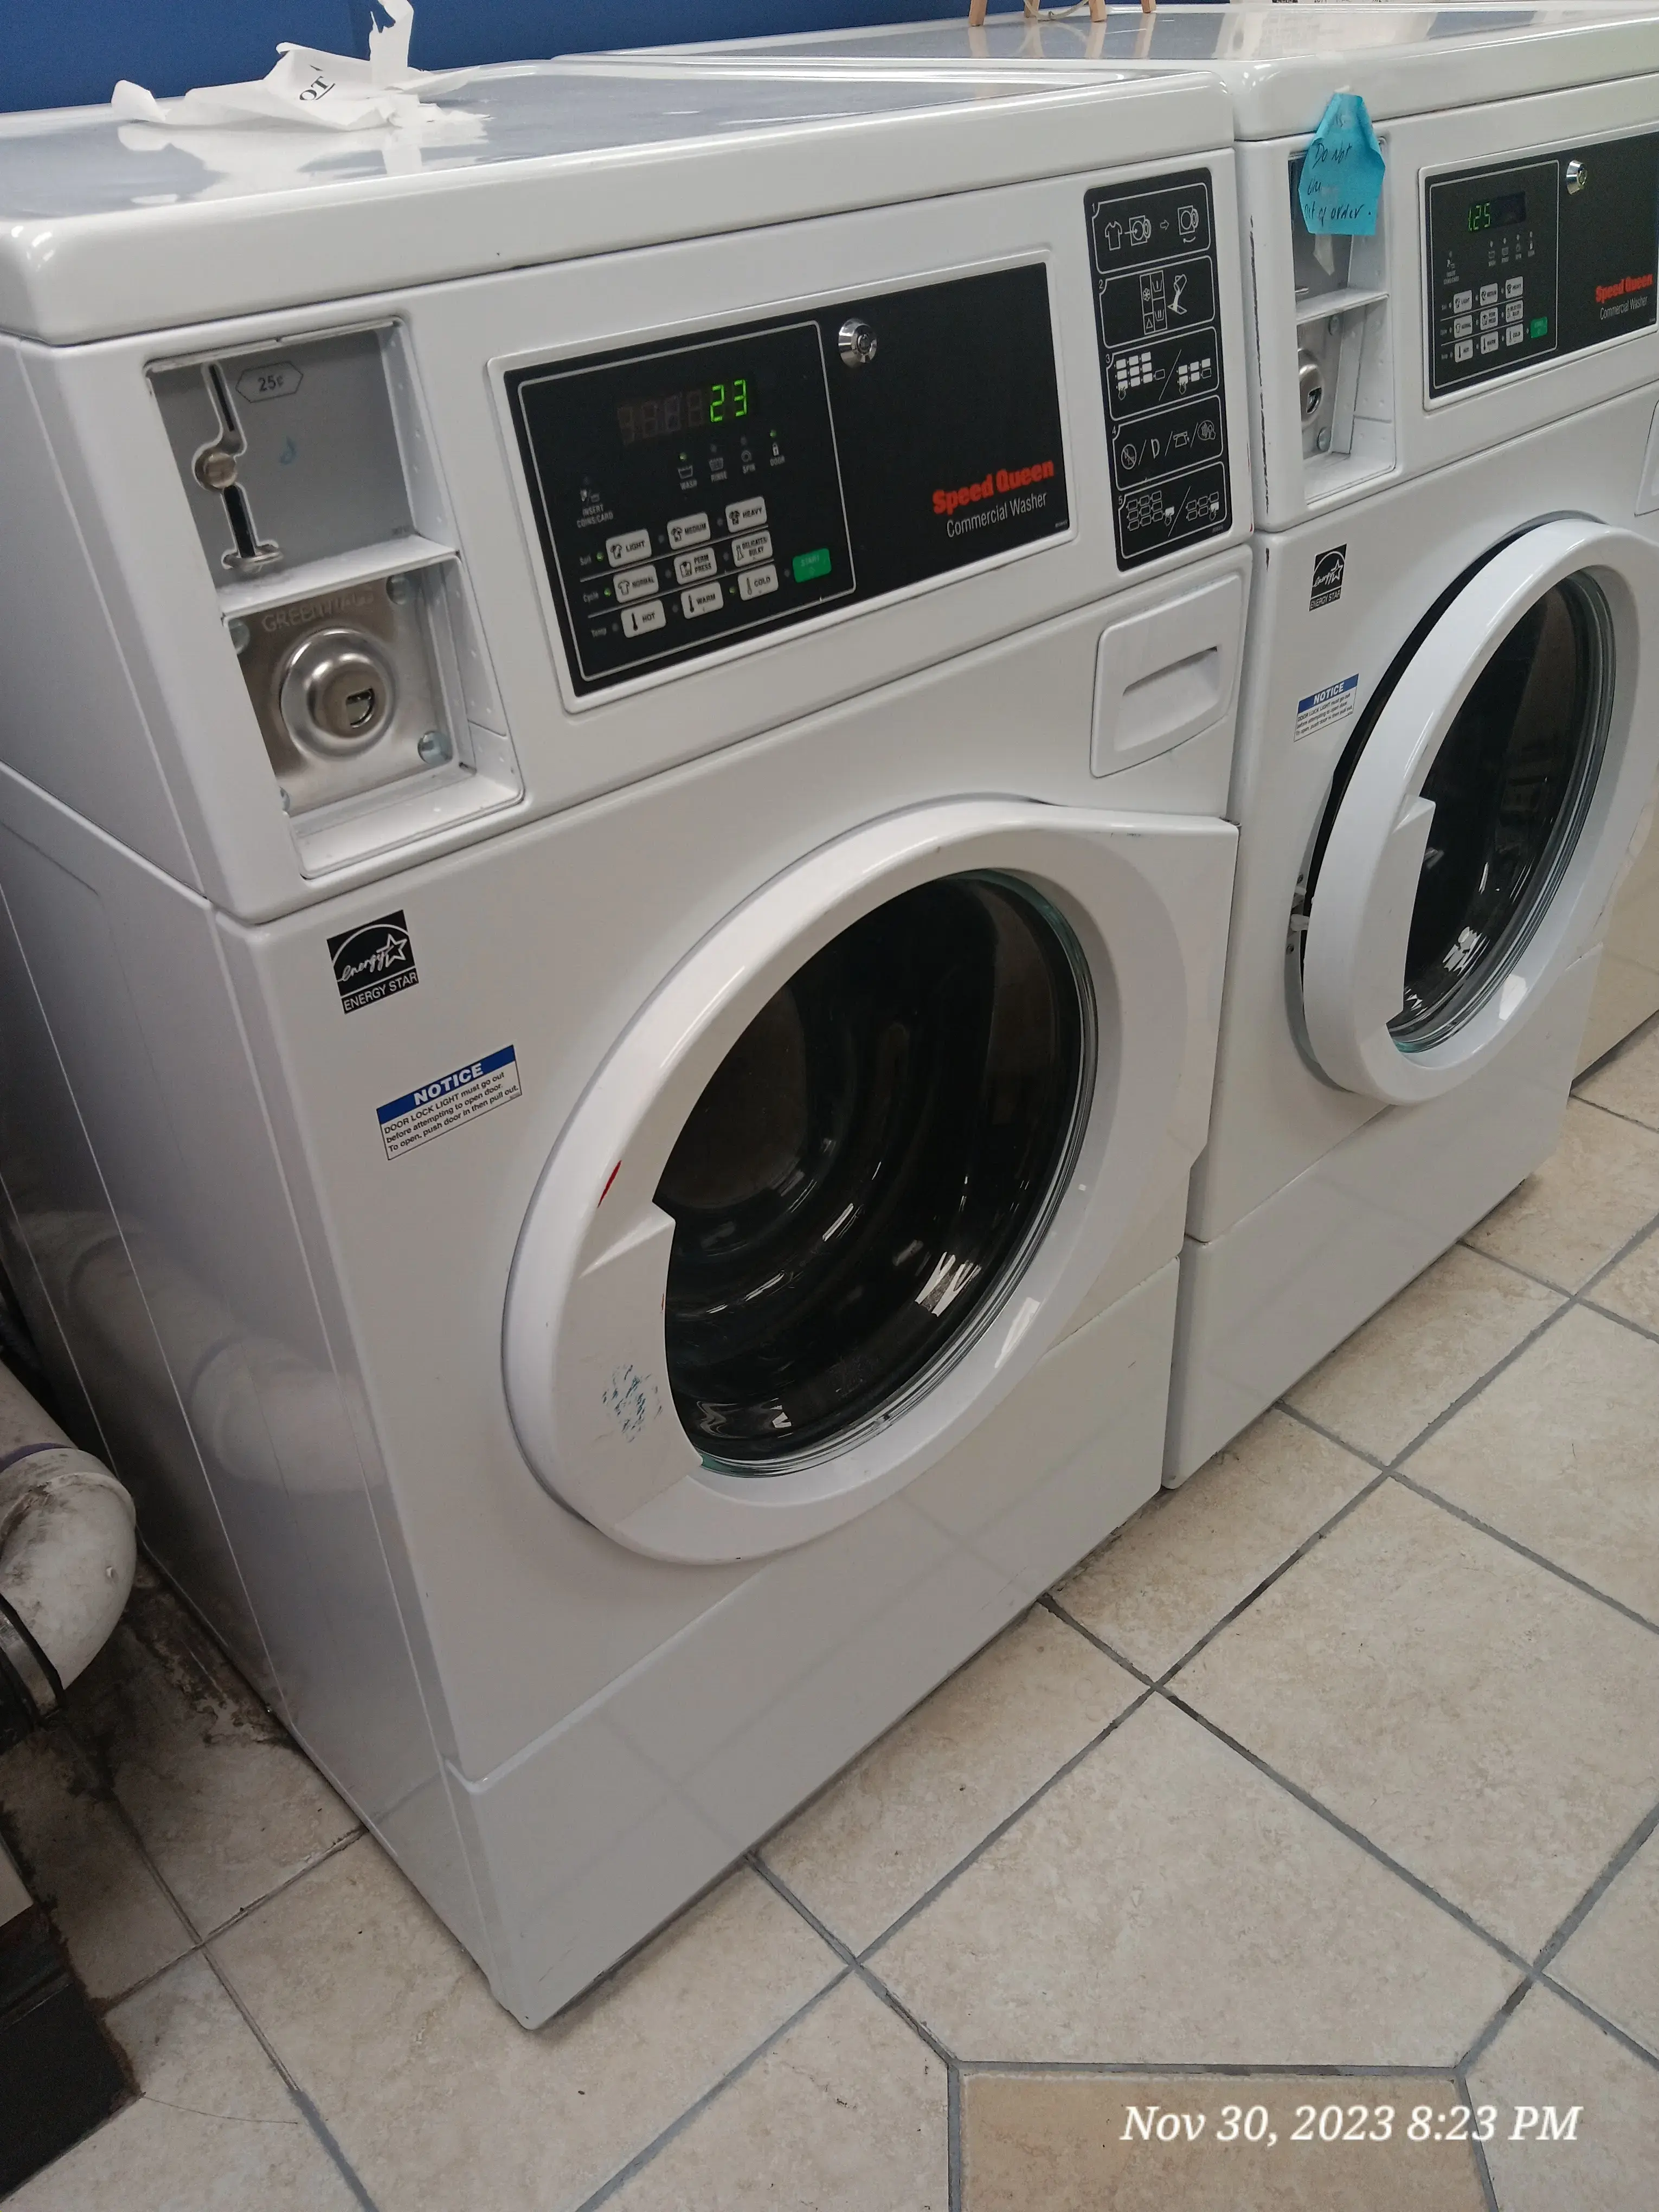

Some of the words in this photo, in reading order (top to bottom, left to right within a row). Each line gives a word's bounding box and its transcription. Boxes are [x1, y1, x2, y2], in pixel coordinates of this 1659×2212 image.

[1596, 278, 1624, 304] Speed
[1625, 273, 1652, 292] Queen
[1600, 300, 1629, 320] Commercial
[1630, 296, 1648, 310] Washer
[710, 379, 747, 423] 23
[932, 473, 994, 515] Speed
[995, 460, 1054, 493] Queen
[582, 503, 604, 517] INSERT
[742, 507, 762, 519] HEAVY
[946, 502, 1008, 538] Commercial
[1009, 491, 1048, 516] Washer
[684, 523, 707, 536] MEDIUM
[625, 541, 645, 552] LIGHT
[749, 545, 764, 557] BULKY
[694, 554, 709, 563] PERM
[695, 563, 712, 574] PRESS
[632, 576, 655, 588] NORMAL
[754, 576, 771, 587] COLD
[696, 594, 716, 605] WARM
[1310, 594, 1328, 609] ENERGY
[1328, 589, 1341, 601] STAR
[642, 612, 655, 622] HOT
[1314, 681, 1345, 705] NOTICE
[344, 983, 387, 1011] ENERGY
[389, 971, 417, 992] STAR
[413, 1063, 484, 1106] NOTICE
[384, 1118, 409, 1134] DOOR
[411, 1105, 435, 1122] LOCK
[435, 1094, 459, 1110] LIGHT
[461, 1084, 480, 1097] must
[481, 1079, 491, 1089] go
[492, 1072, 505, 1082] out
[387, 1127, 411, 1143] before
[413, 1107, 454, 1130] attempting
[455, 1102, 464, 1110] to
[465, 1093, 483, 1108] open
[388, 1143, 399, 1153] To
[423, 1122, 443, 1139] push
[443, 1113, 462, 1126] door
[462, 1109, 471, 1117] in
[472, 1100, 488, 1113] then
[489, 1091, 504, 1105] pull
